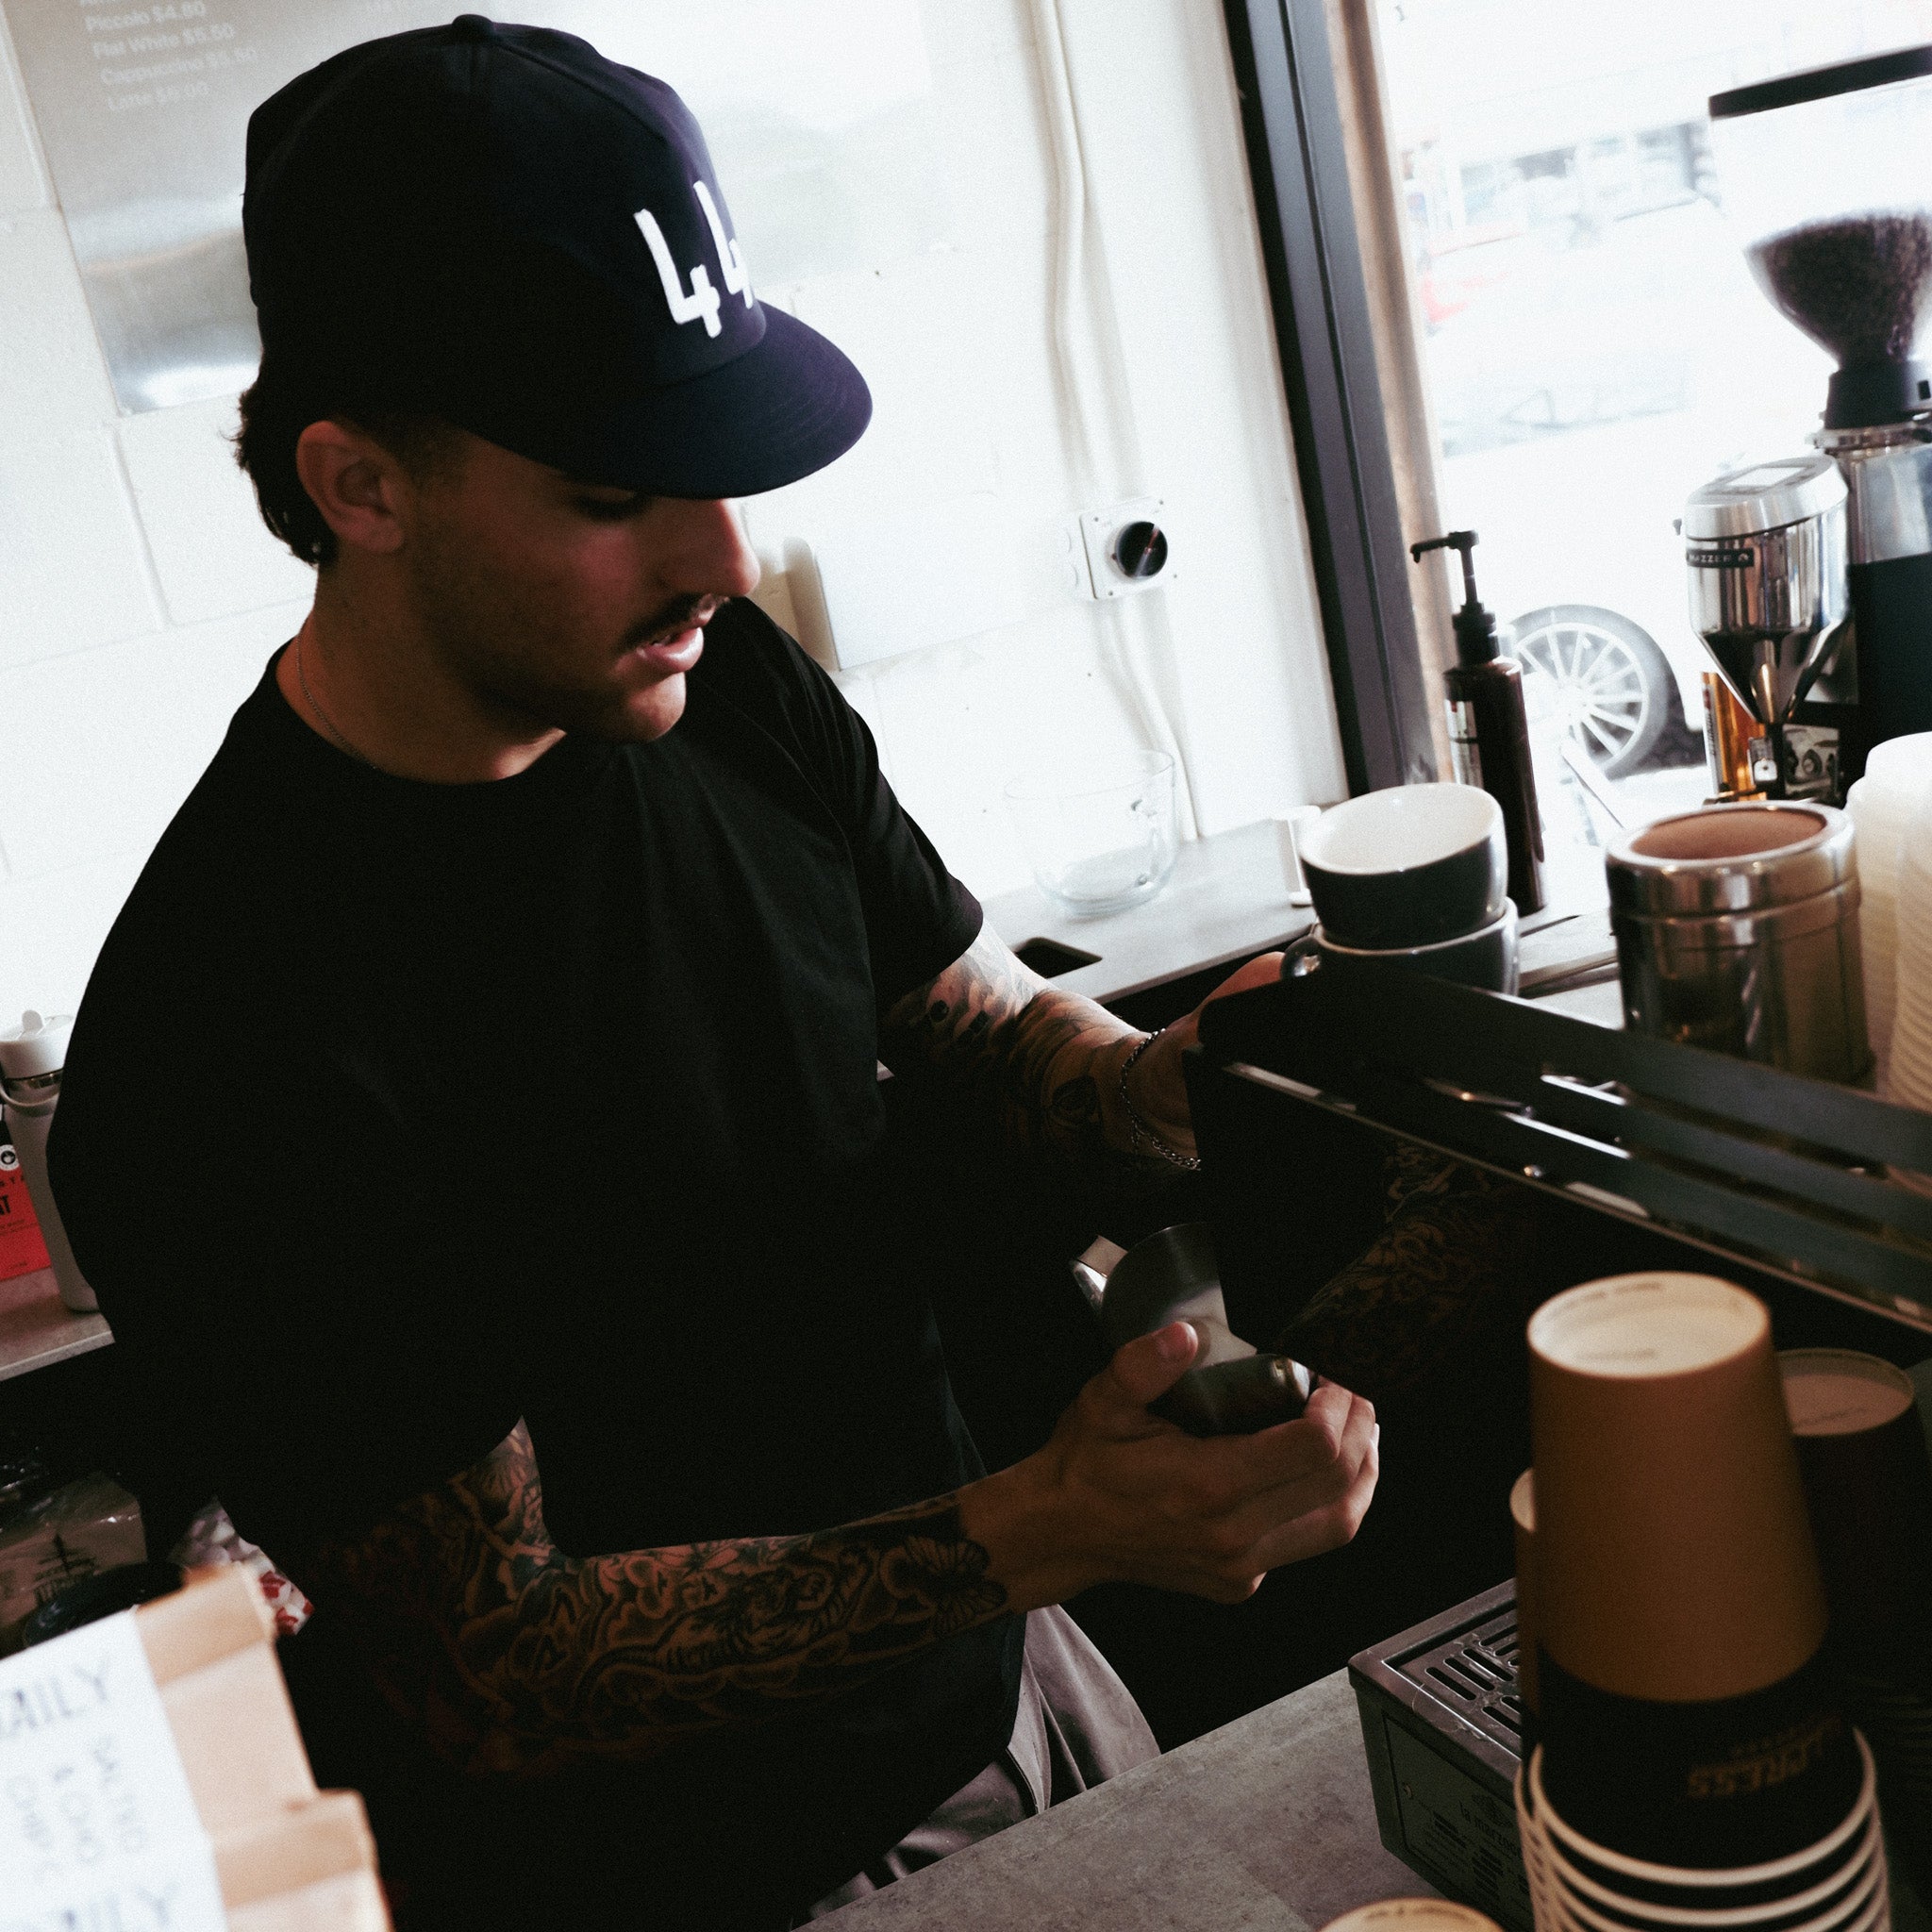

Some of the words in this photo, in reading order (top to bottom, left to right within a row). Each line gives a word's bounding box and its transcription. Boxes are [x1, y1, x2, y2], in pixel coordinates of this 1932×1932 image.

[85, 9, 151, 33] Piccolo
[92, 40, 126, 59] Flat
[128, 33, 179, 54] White
[634, 180, 754, 338] 44
[0, 1653, 111, 1739] AILY
